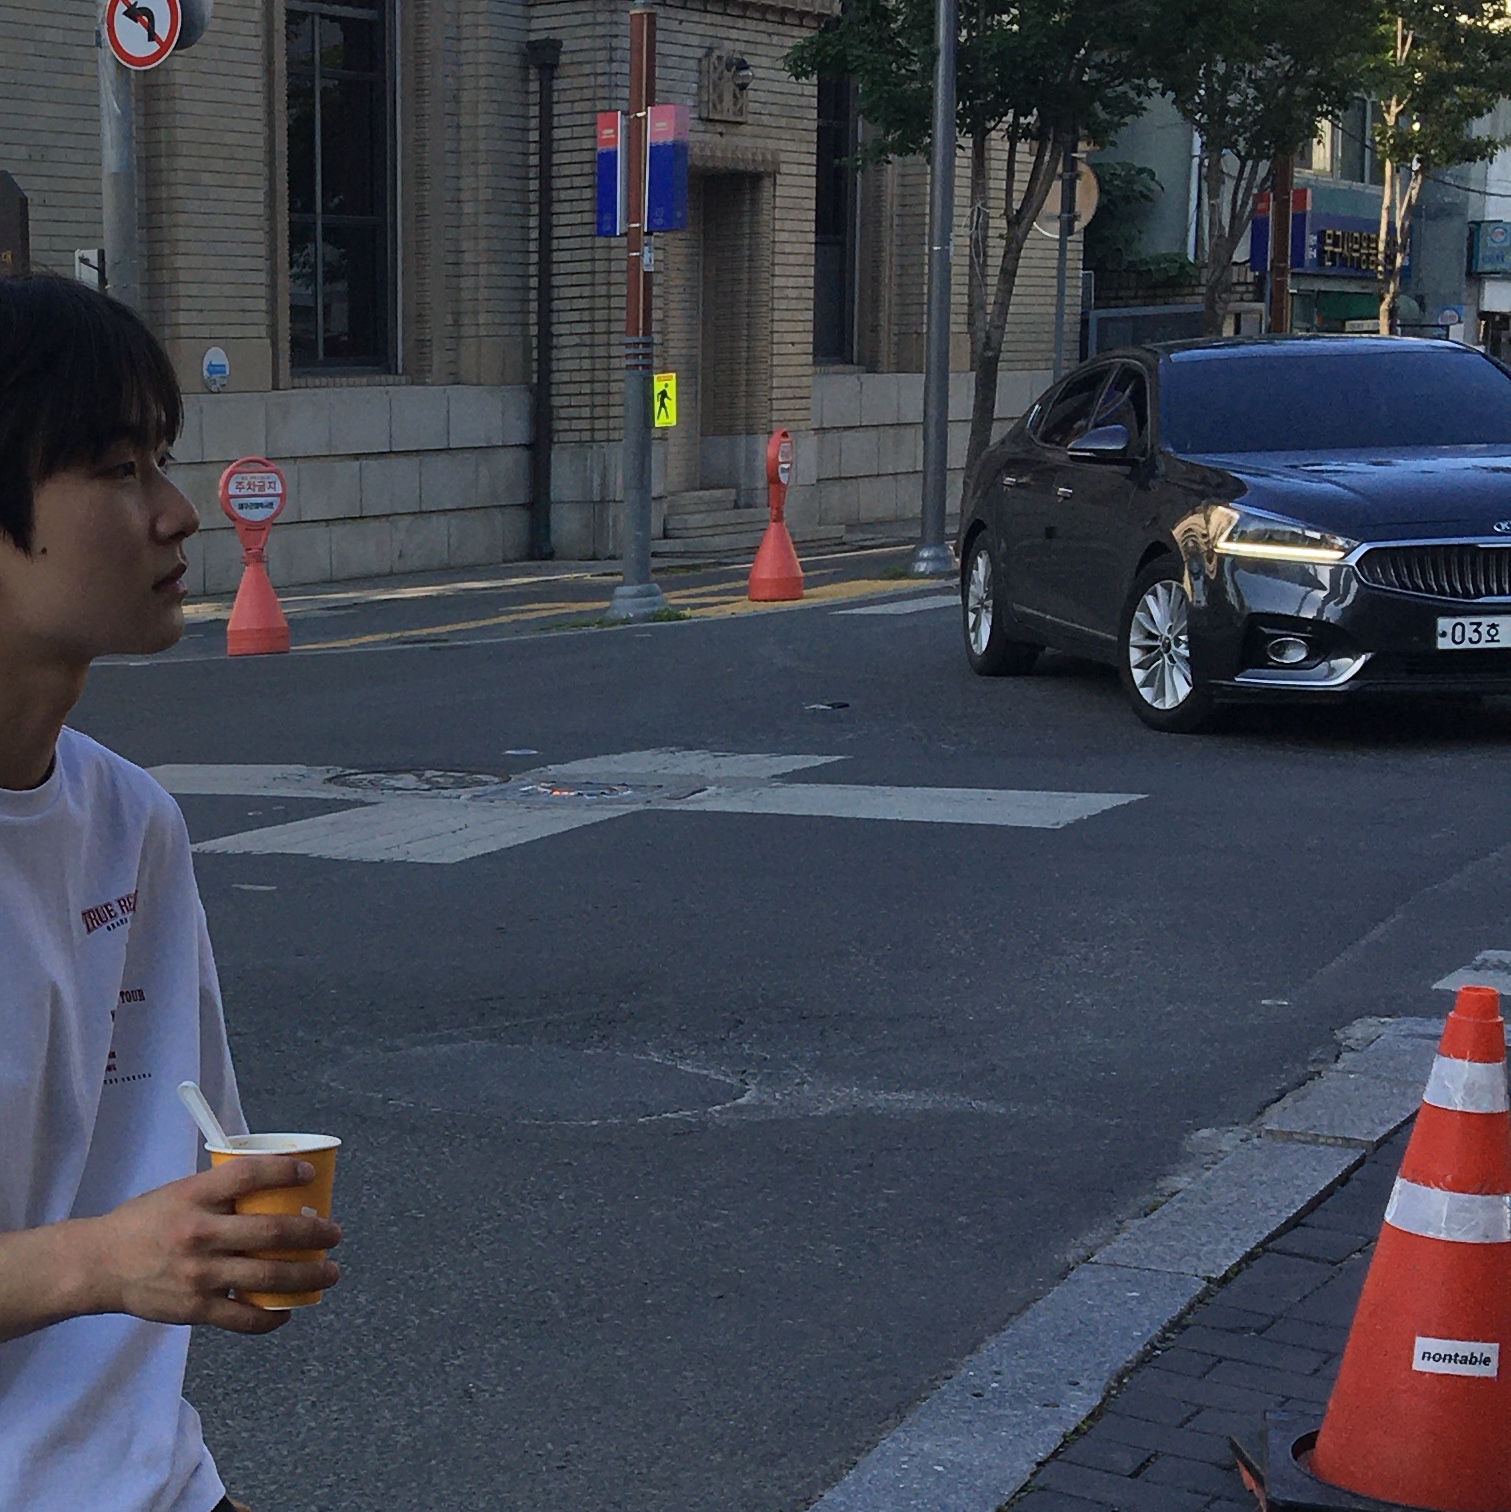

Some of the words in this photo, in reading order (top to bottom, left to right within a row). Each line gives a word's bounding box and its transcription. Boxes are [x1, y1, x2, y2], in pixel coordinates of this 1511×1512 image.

[235, 481, 276, 493] 주차금지
[1451, 622, 1500, 645] 03호
[81, 902, 117, 935] TRUE
[119, 989, 145, 1004] TOUR
[1421, 1351, 1491, 1366] nontable
